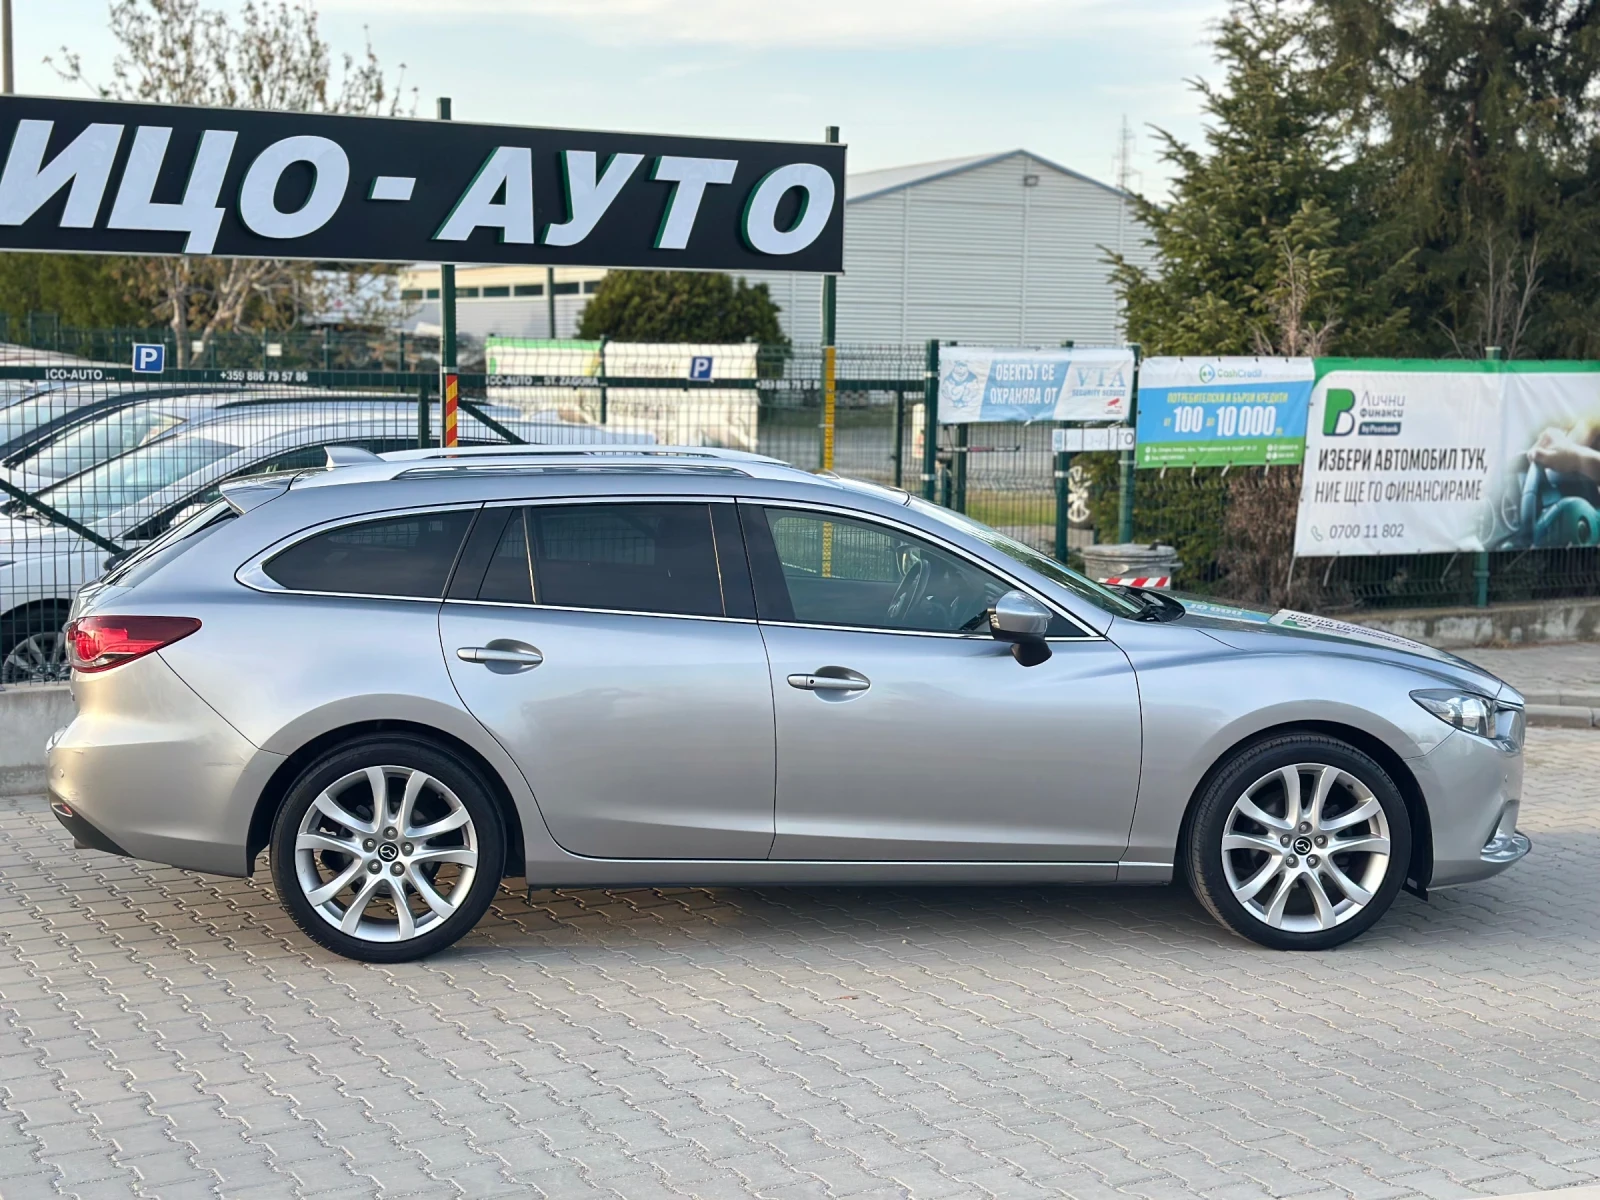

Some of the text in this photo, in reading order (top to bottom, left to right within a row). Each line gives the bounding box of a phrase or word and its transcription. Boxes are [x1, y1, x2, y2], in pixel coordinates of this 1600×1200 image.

[140, 348, 157, 369] P
[693, 358, 709, 372] P
[268, 371, 279, 381] 79
[281, 371, 293, 382] 57
[995, 363, 1055, 381] ОБЕКТЪТ СЕ
[1075, 367, 1127, 387] VTA
[1217, 368, 1262, 379] CashCredit
[990, 387, 1058, 405] ОХРАНЯВА ОТ
[1072, 388, 1100, 397] SECURITY
[1360, 390, 1405, 407] Лични
[1173, 405, 1204, 433] 100
[1318, 447, 1488, 474] ИЗБЕРИ АВТОМОБИЛ ТУК,
[1314, 479, 1482, 507] НИЕ ЩЕ ГО ФИНАНСИРАМЕ
[1329, 524, 1404, 539] 0700 11 802
